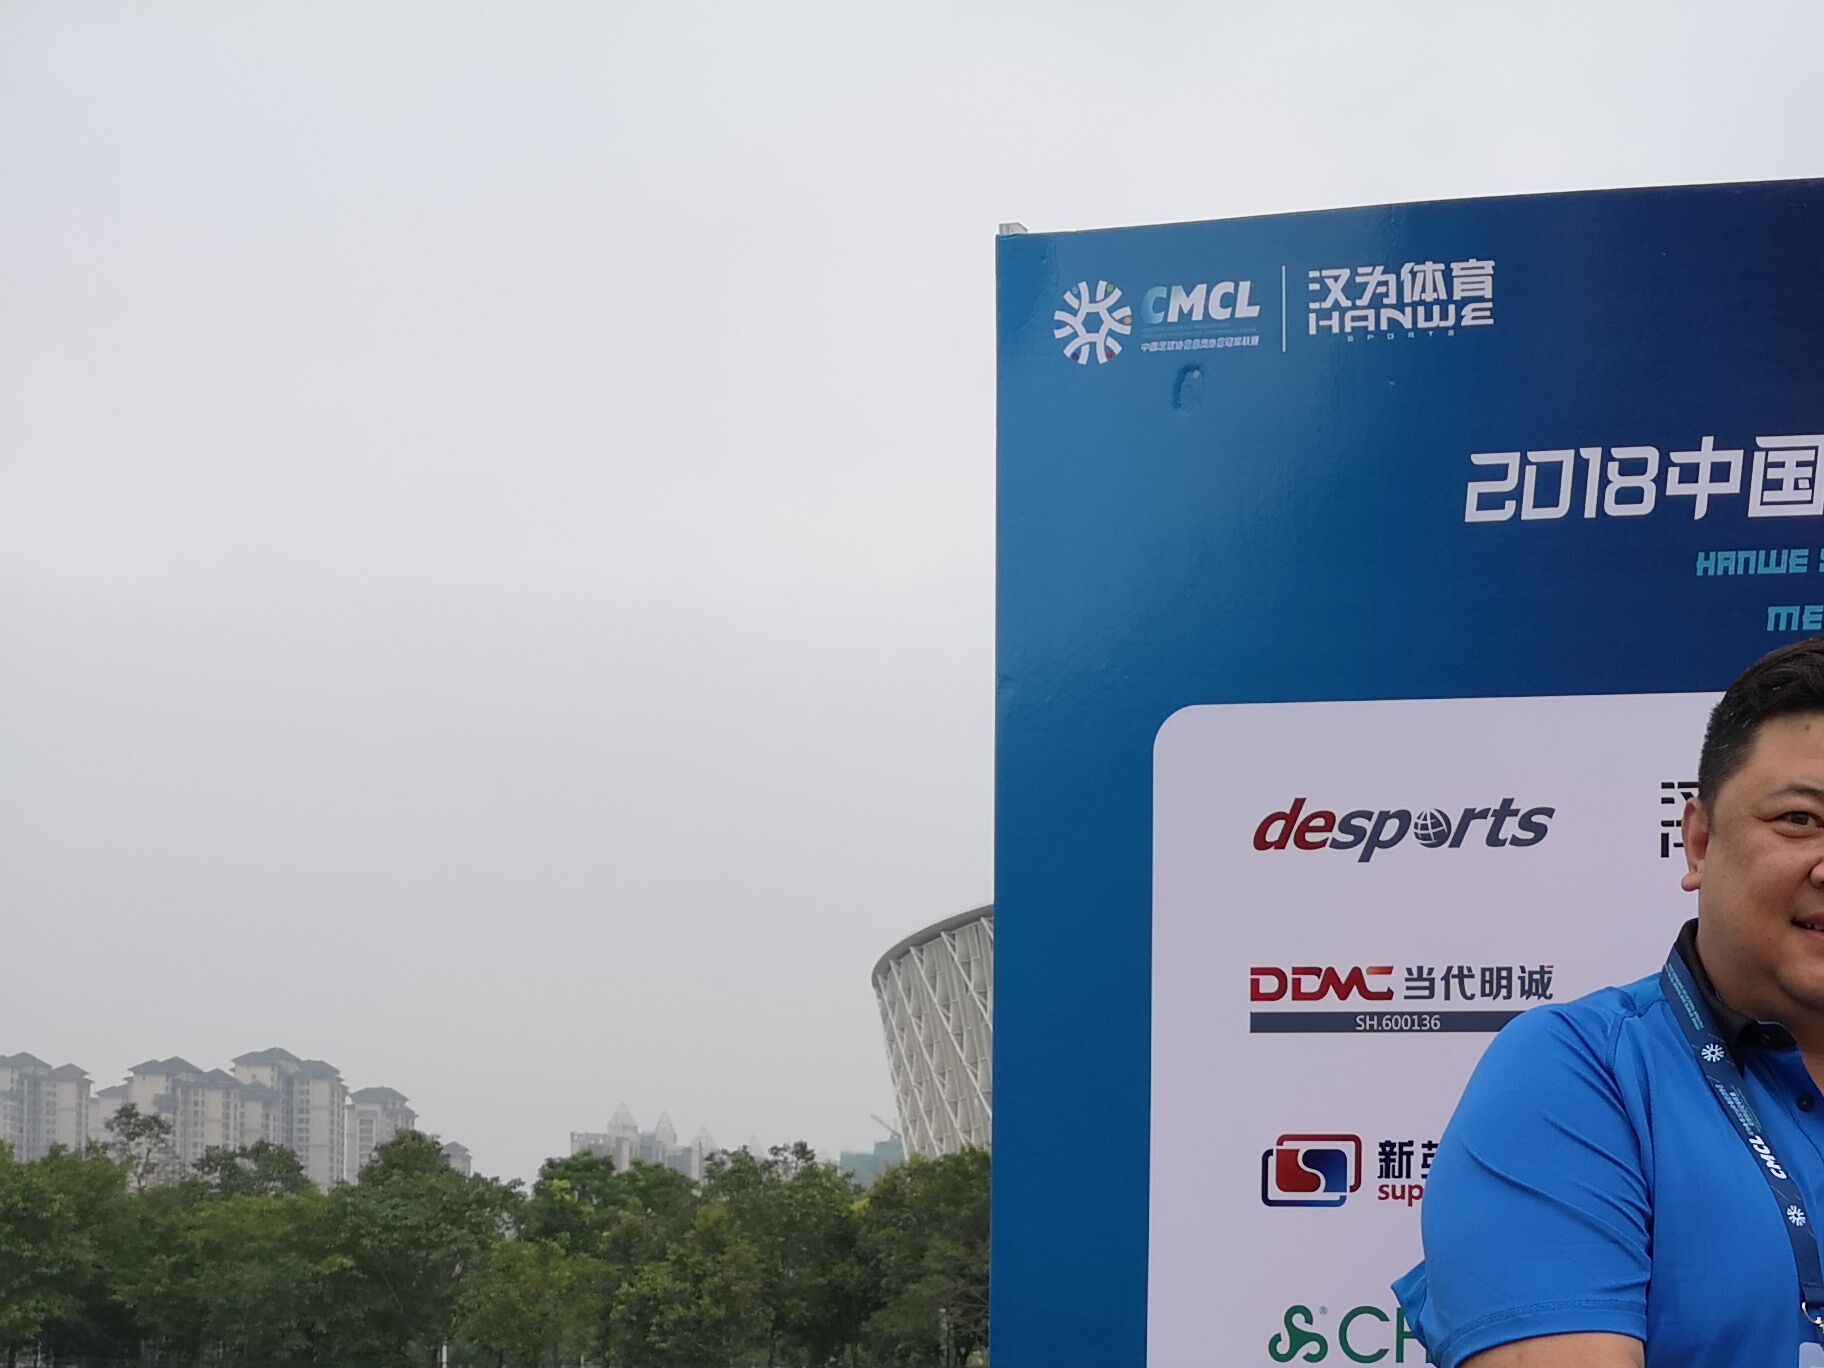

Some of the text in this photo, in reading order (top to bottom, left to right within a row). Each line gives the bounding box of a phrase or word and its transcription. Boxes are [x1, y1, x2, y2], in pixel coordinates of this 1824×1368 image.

[1141, 281, 1260, 324] CMCL
[1308, 259, 1496, 309] 汉为体育
[1308, 302, 1496, 335] HANWE
[1696, 548, 1809, 577] HANWE
[1252, 797, 1556, 863] desports
[1250, 965, 1555, 1002] DDMC 当代明诚
[1355, 1014, 1441, 1032] SH.600136
